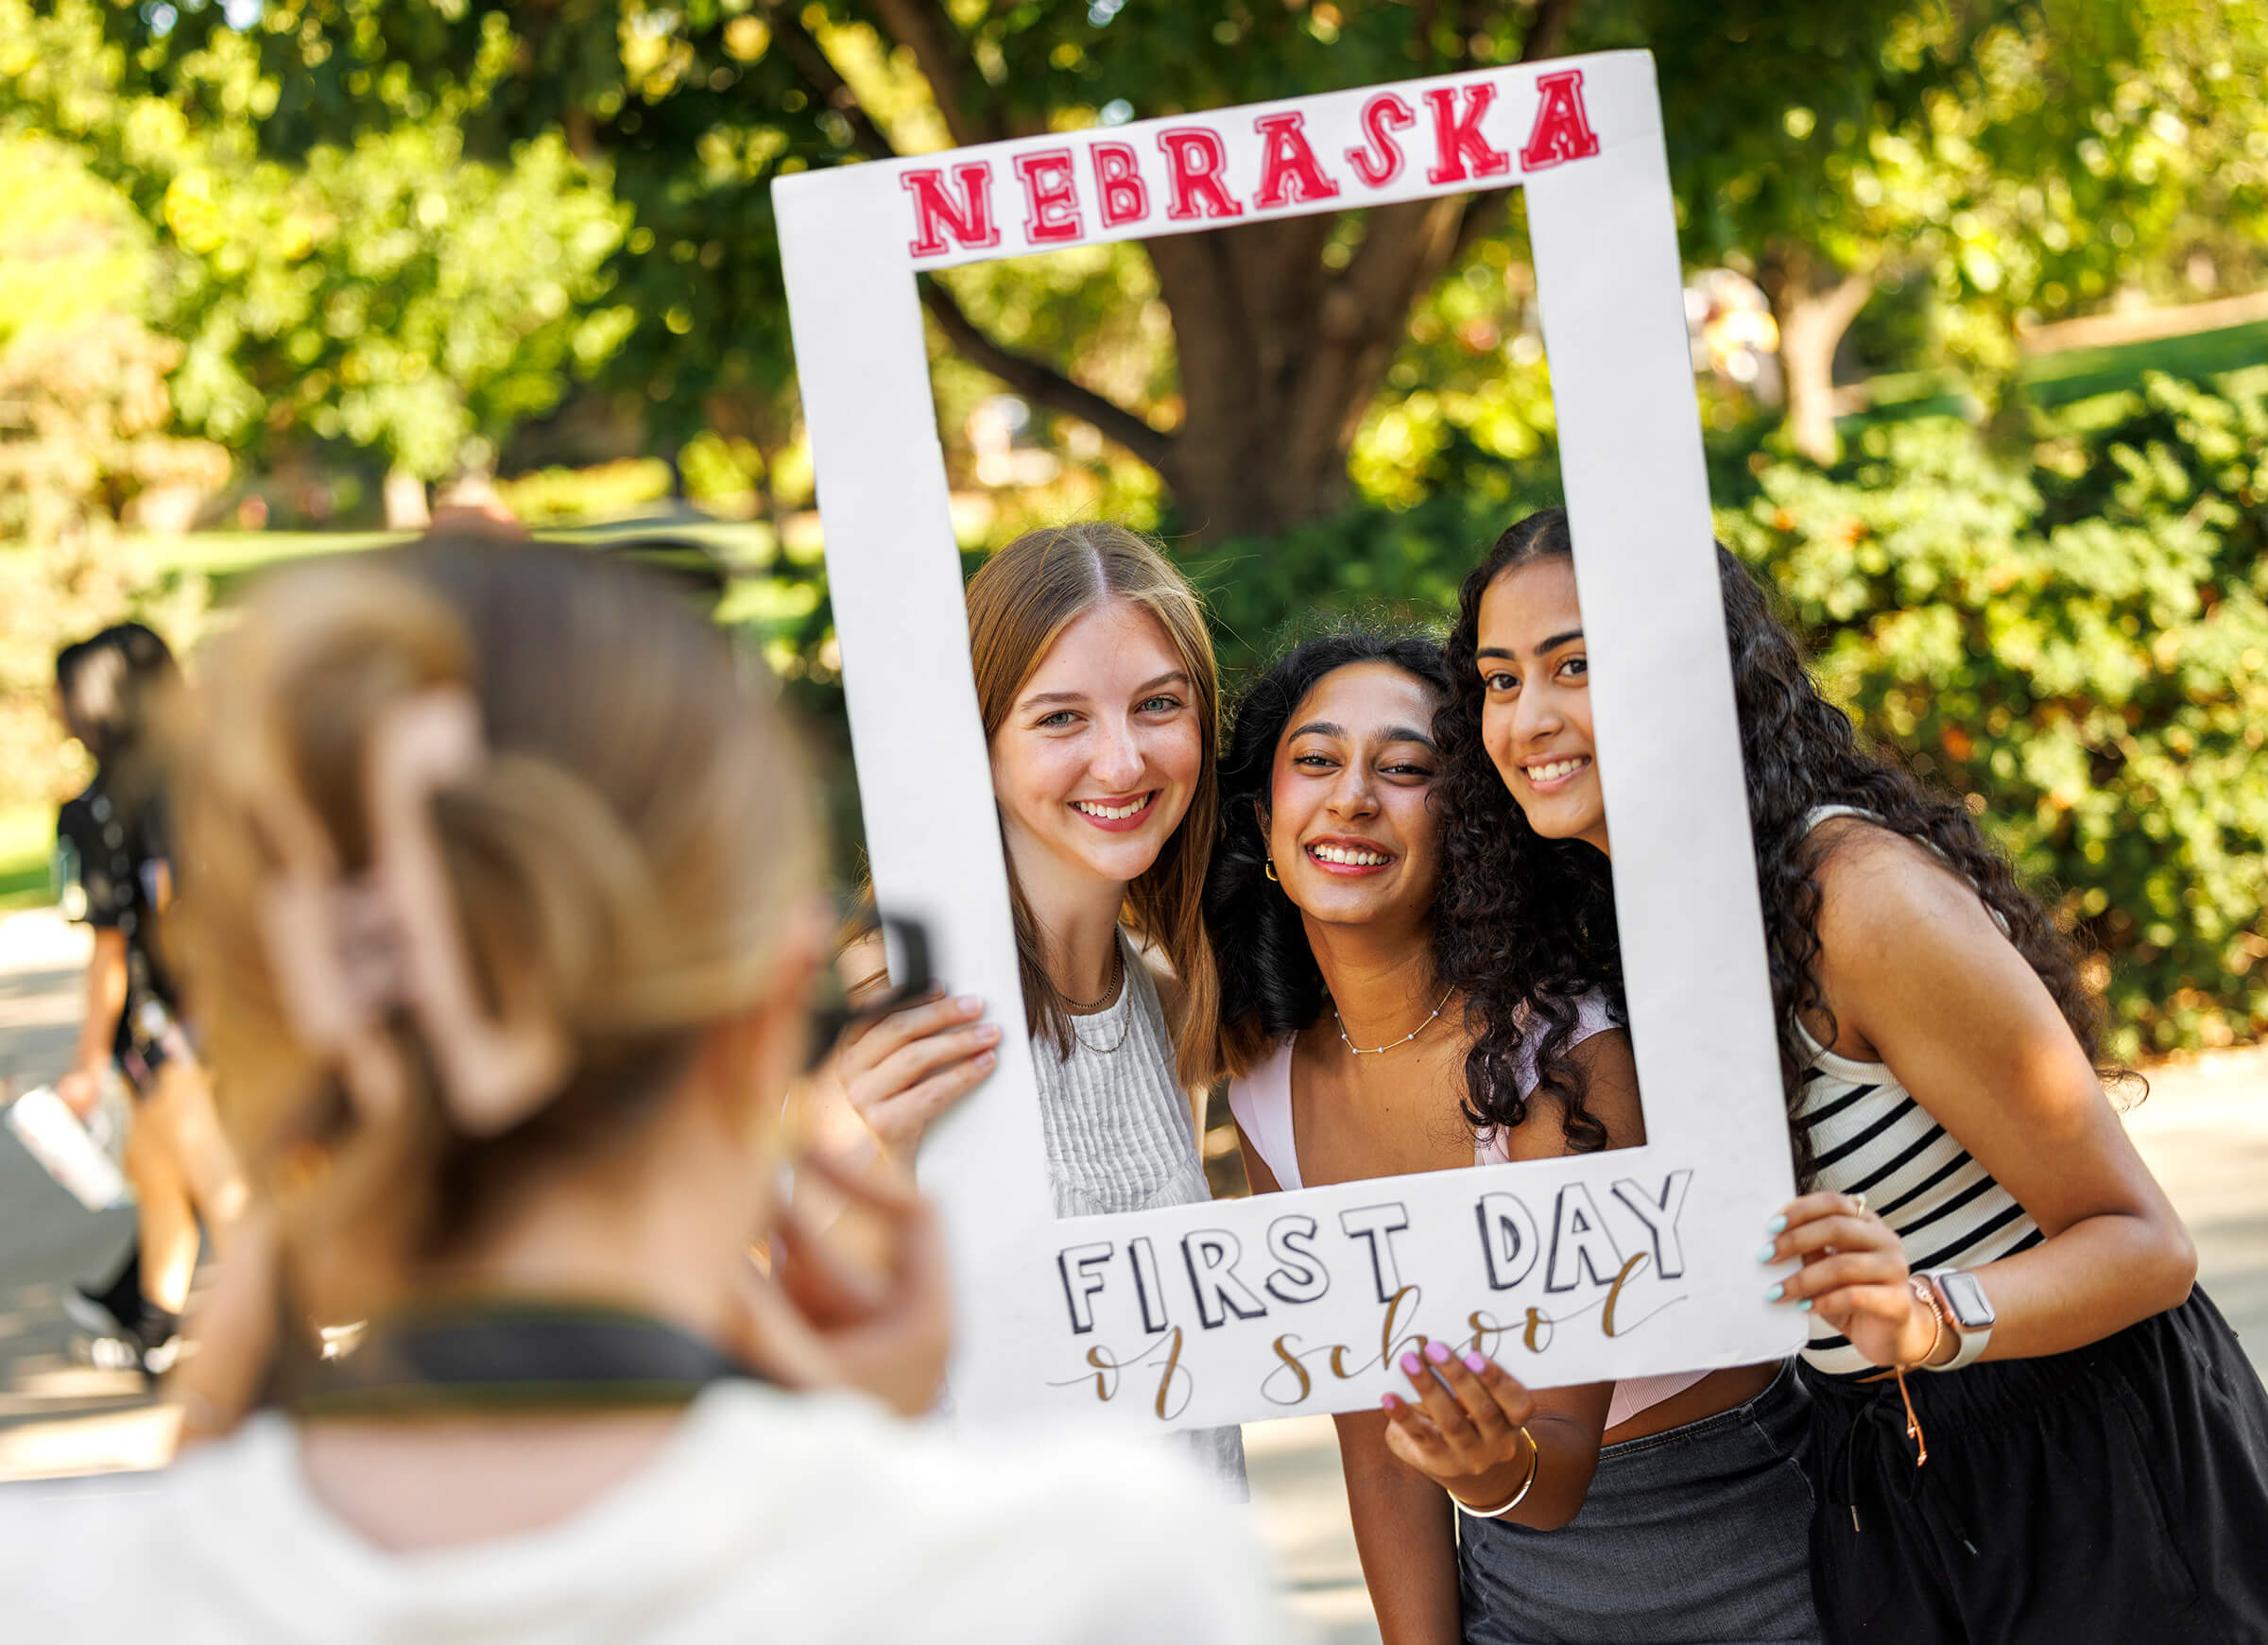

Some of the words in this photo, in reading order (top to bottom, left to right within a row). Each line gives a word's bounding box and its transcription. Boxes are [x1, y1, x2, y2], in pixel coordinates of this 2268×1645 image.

[900, 69, 1599, 257] NEBRASKA
[1046, 1326, 1193, 1420] of
[1261, 1252, 1689, 1406] school
[1057, 1202, 1408, 1333] FIRST
[1475, 1171, 1693, 1293] DAY
